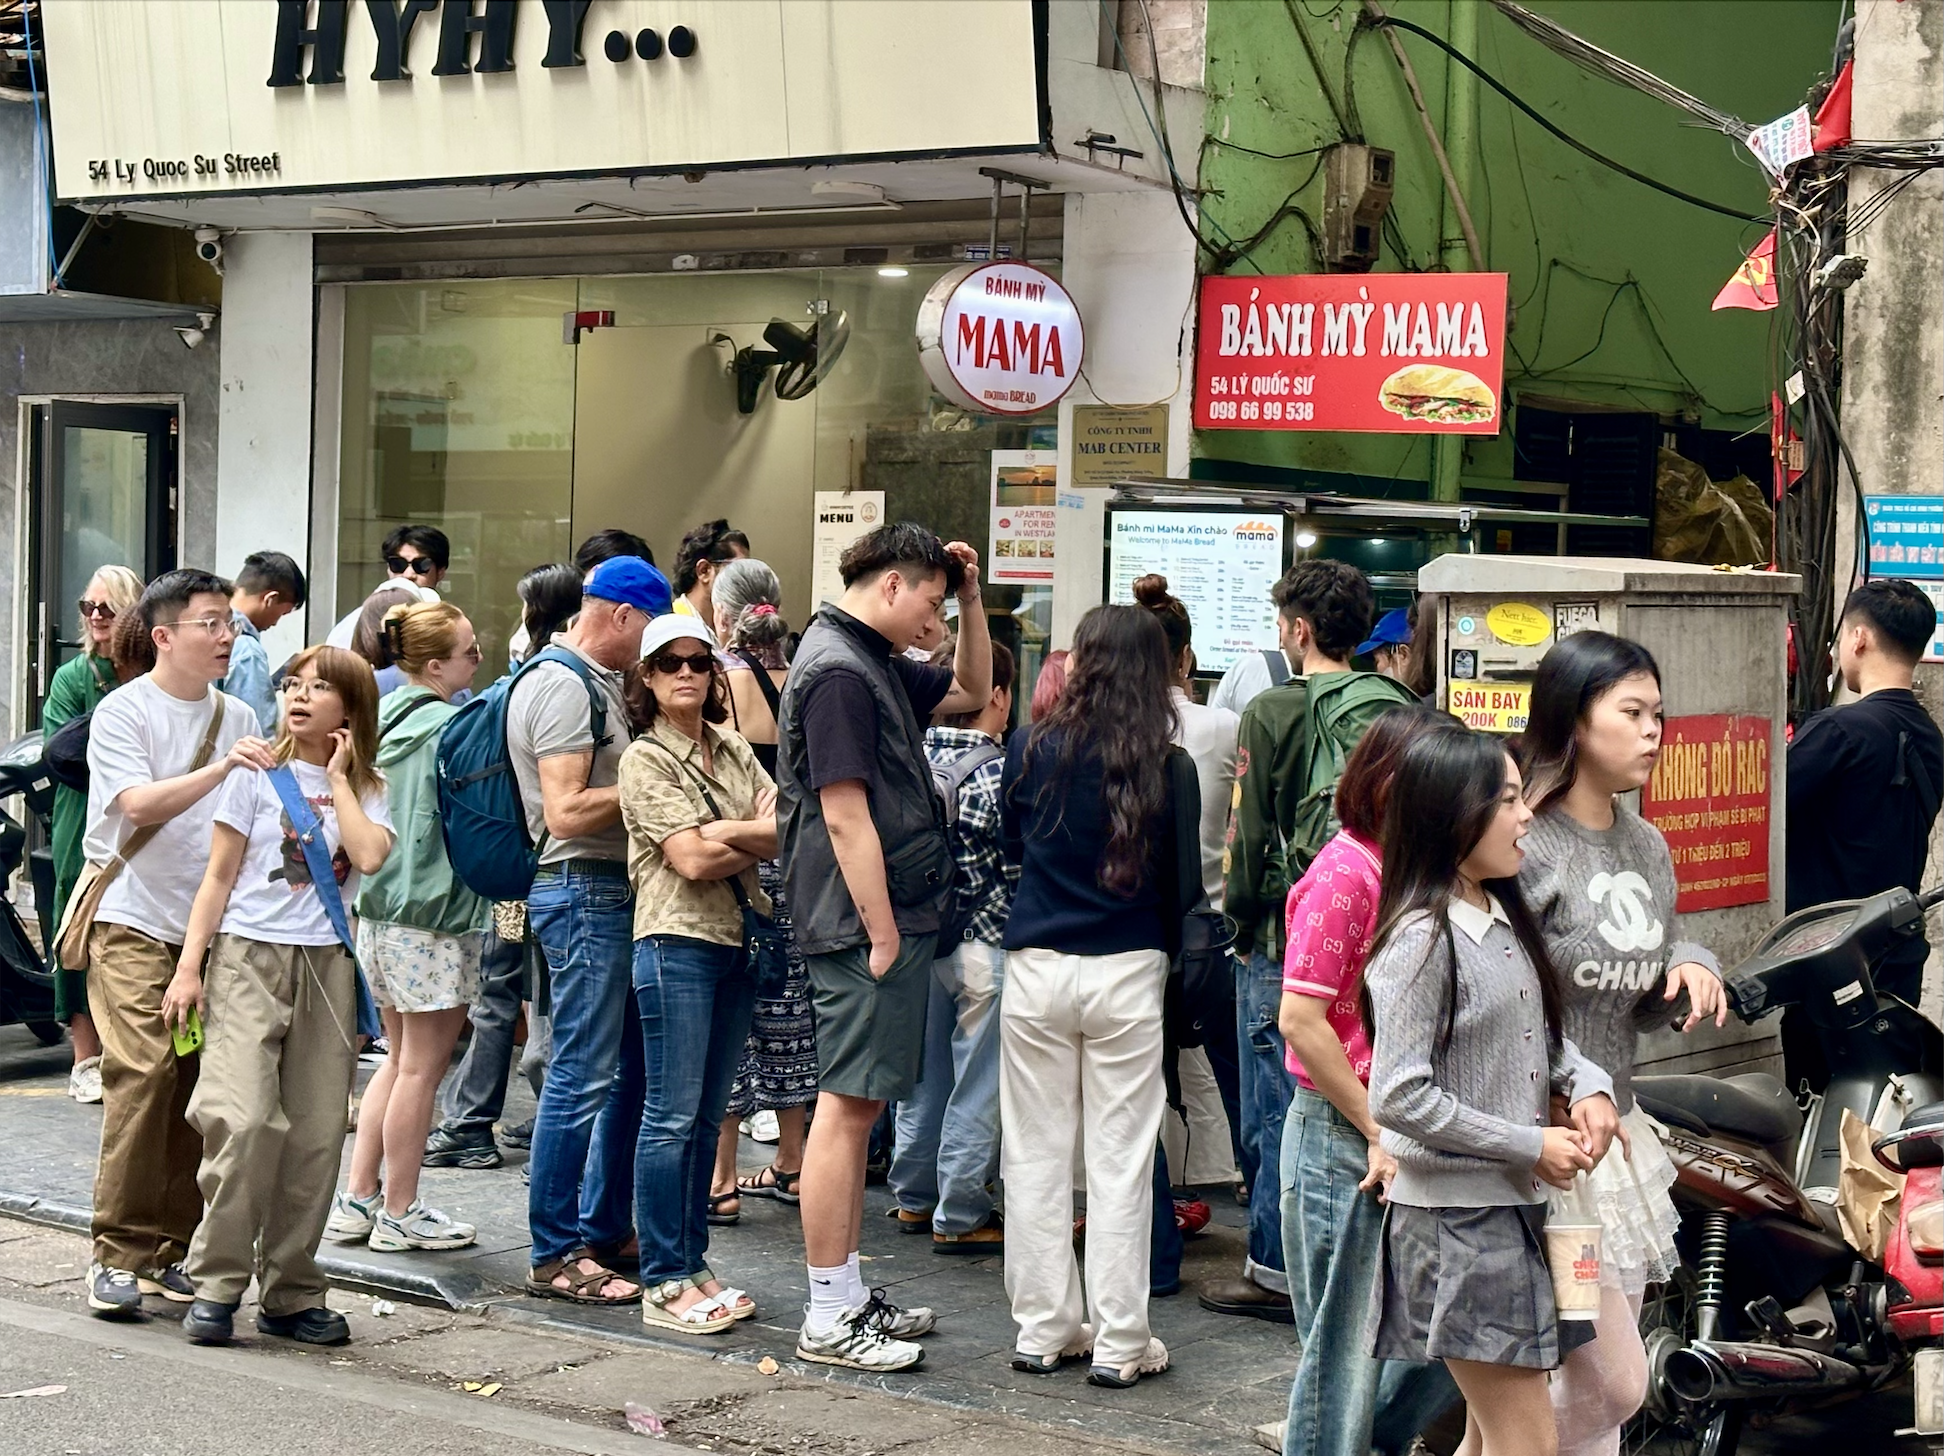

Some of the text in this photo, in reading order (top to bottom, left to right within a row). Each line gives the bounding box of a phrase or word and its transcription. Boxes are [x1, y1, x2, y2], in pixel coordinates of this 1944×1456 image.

[88, 152, 280, 183] 54 Ly Quoc Su Street
[985, 273, 1046, 303] BÁNH MỲ
[1219, 285, 1490, 357] BÁNH MỲ MAMA
[957, 313, 1065, 378] MAMA
[1210, 376, 1228, 395] 54
[1251, 369, 1290, 397] QUỐC
[1293, 374, 1316, 396] SƯ
[1009, 390, 1036, 404] BREAD
[1209, 401, 1314, 421] 098 66 99 538
[1087, 426, 1153, 435] CÔNG TY TNHH
[1078, 441, 1161, 455] MAB CENTER
[820, 513, 854, 523] MENU
[1023, 520, 1039, 528] FOR
[1117, 523, 1140, 533] Bánh
[1157, 524, 1184, 534] MaMa
[1204, 525, 1228, 535] chào
[1236, 530, 1274, 541] mama
[1128, 536, 1160, 545] Welcome
[1194, 538, 1215, 546] Bread
[1453, 687, 1522, 710] SÂN BAY
[1462, 711, 1497, 727] 200K
[1651, 731, 1707, 802] KHÔNG
[1736, 726, 1767, 795] RÁC
[1682, 848, 1686, 864] 1
[1725, 843, 1730, 859] 2
[1573, 960, 1664, 991] CHAN
